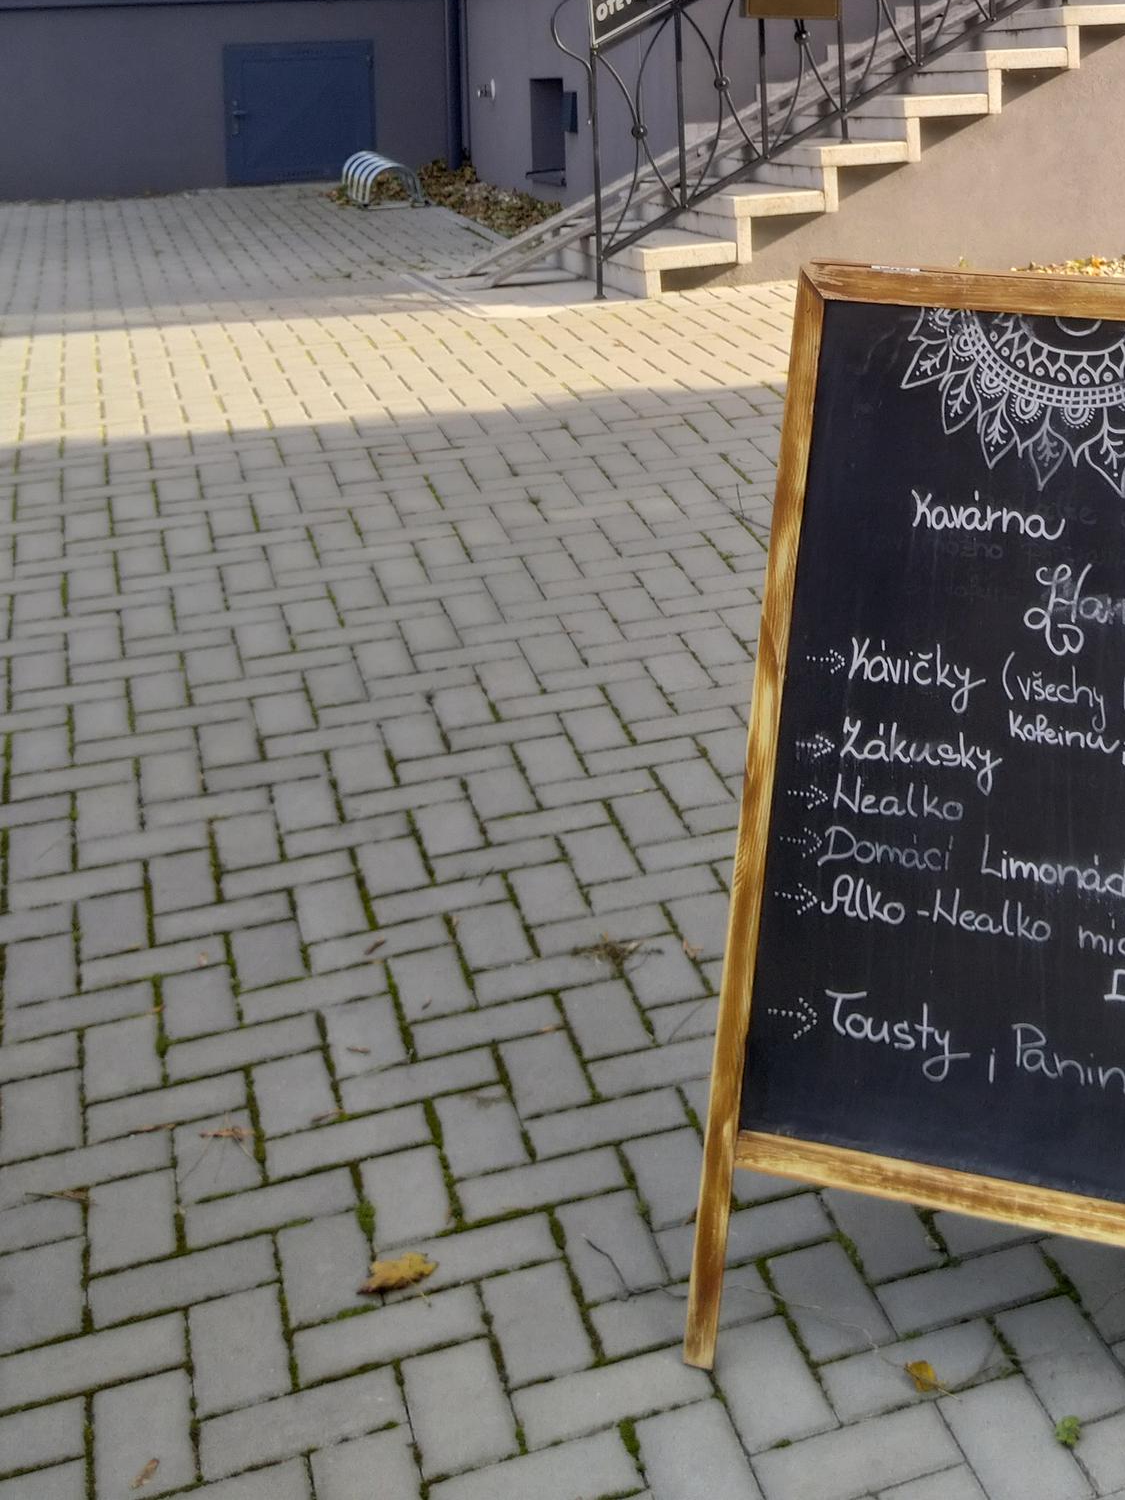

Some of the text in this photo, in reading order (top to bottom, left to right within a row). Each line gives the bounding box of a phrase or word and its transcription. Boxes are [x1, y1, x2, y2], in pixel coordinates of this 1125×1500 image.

[911, 489, 1066, 540] Kavárna
[848, 637, 986, 714] Kávičky
[839, 716, 1003, 796] Zákusky
[833, 773, 964, 821] Nealko
[817, 825, 954, 871] Domácí
[824, 989, 972, 1082] Tousty
